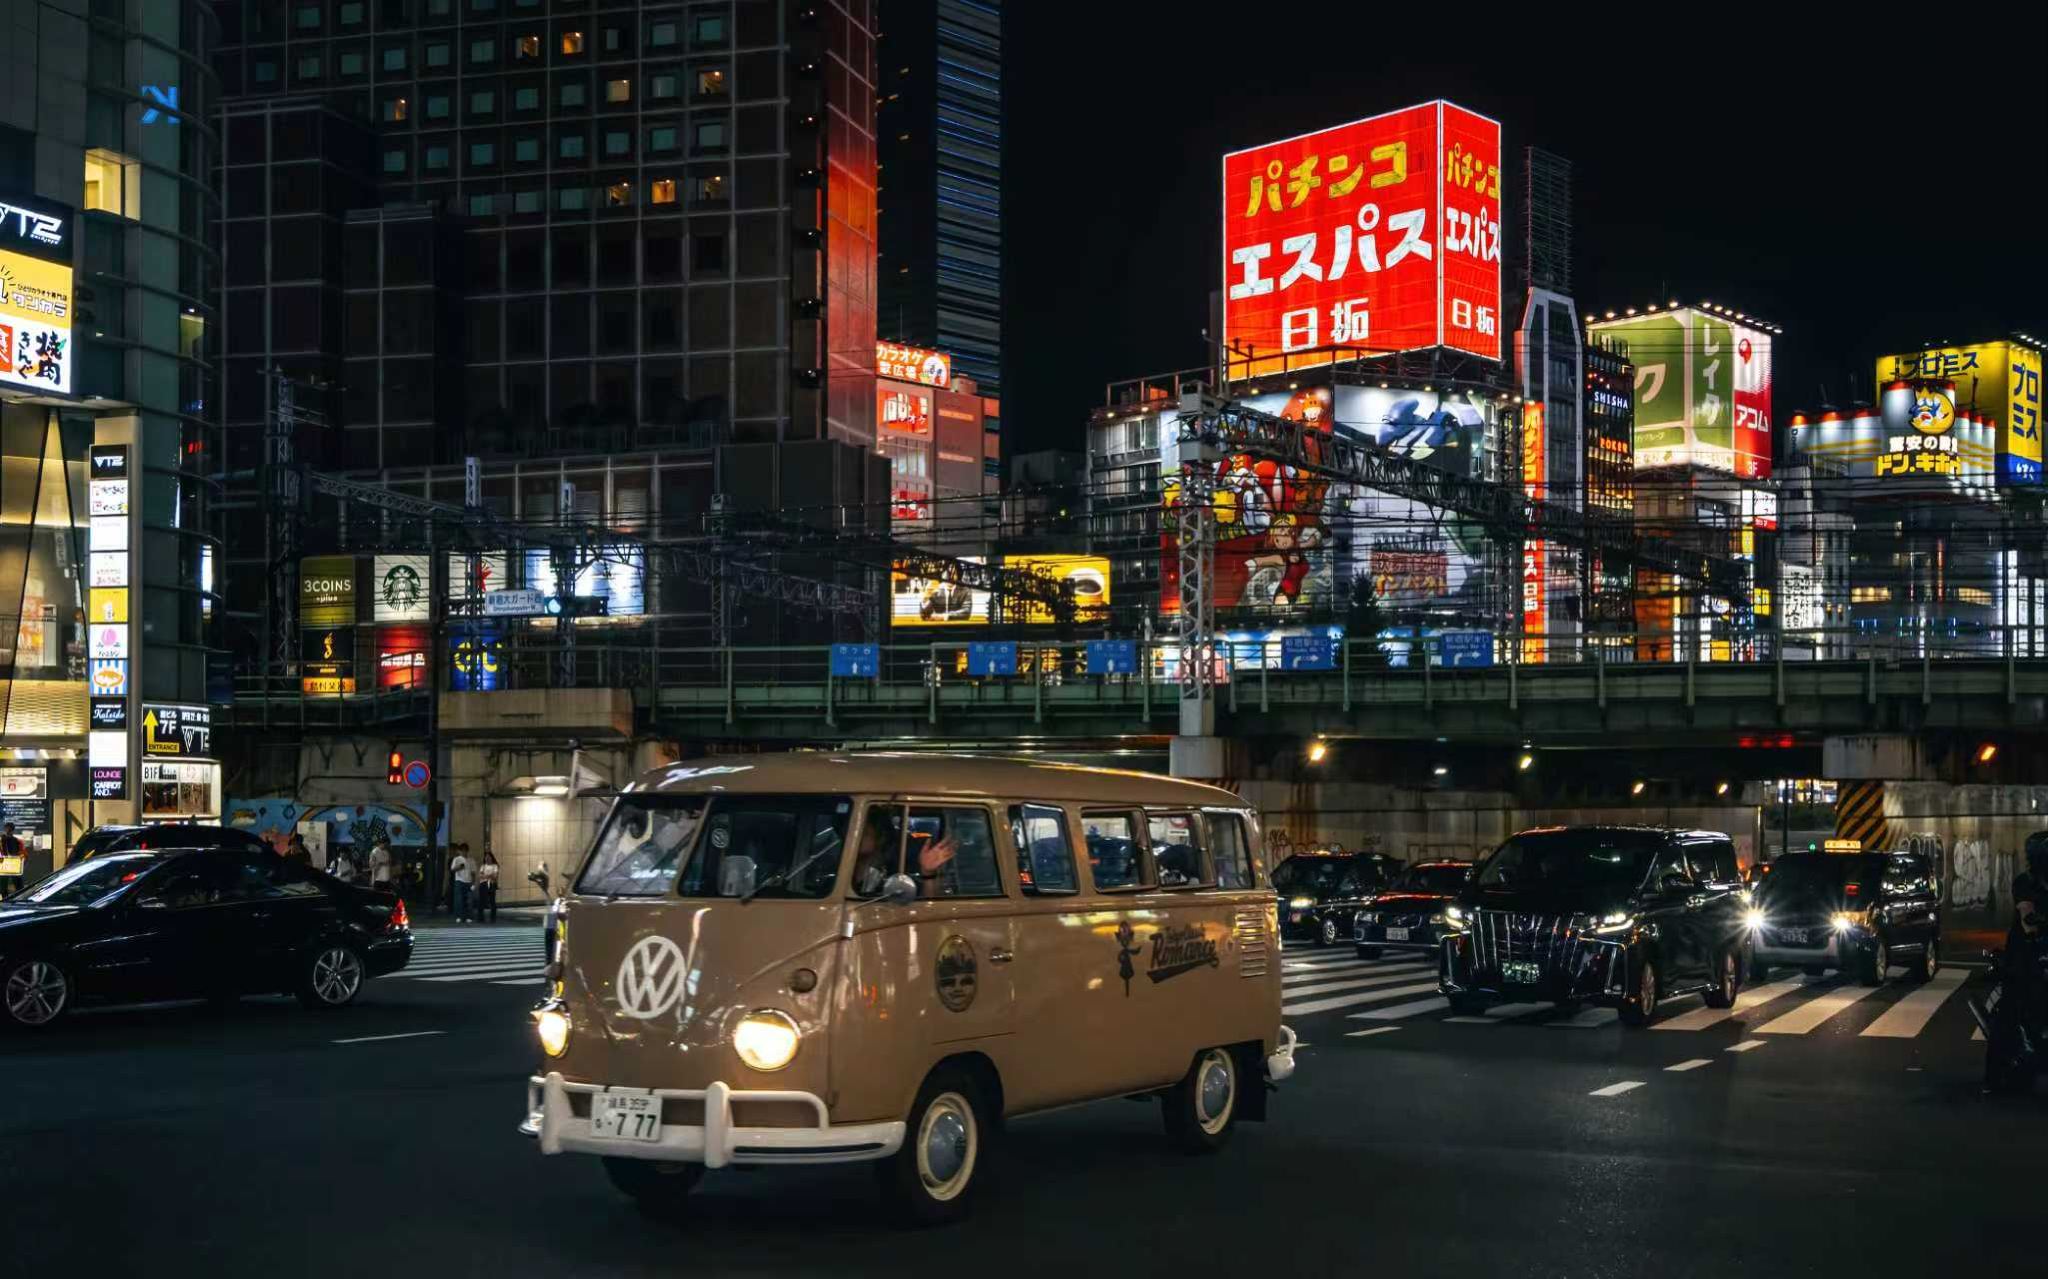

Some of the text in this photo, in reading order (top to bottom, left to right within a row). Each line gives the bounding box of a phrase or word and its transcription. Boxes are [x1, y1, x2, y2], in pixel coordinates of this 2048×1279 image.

[1246, 141, 1407, 218] パチンコ
[1446, 142, 1500, 200] パチンコ
[1445, 206, 1500, 264] エスパス
[1229, 203, 1433, 301] エスパス
[13, 292, 67, 317] ワンカラ
[1452, 298, 1495, 337] 日拓
[1282, 298, 1370, 353] 日拓
[18, 331, 33, 379] きんぐ
[35, 330, 66, 385] 焼肉
[876, 344, 924, 365] カラオケ
[880, 361, 917, 380] 歌広場
[1702, 323, 1721, 426] レイク
[1594, 391, 1628, 409] SHISHA
[1736, 404, 1769, 433] アコム
[1600, 437, 1628, 453] POKER
[304, 580, 352, 593] 3COINS
[160, 720, 177, 735] 7F
[148, 743, 178, 751] ENTRANCE
[94, 769, 121, 779] LOUNGE
[144, 766, 158, 779] B1F
